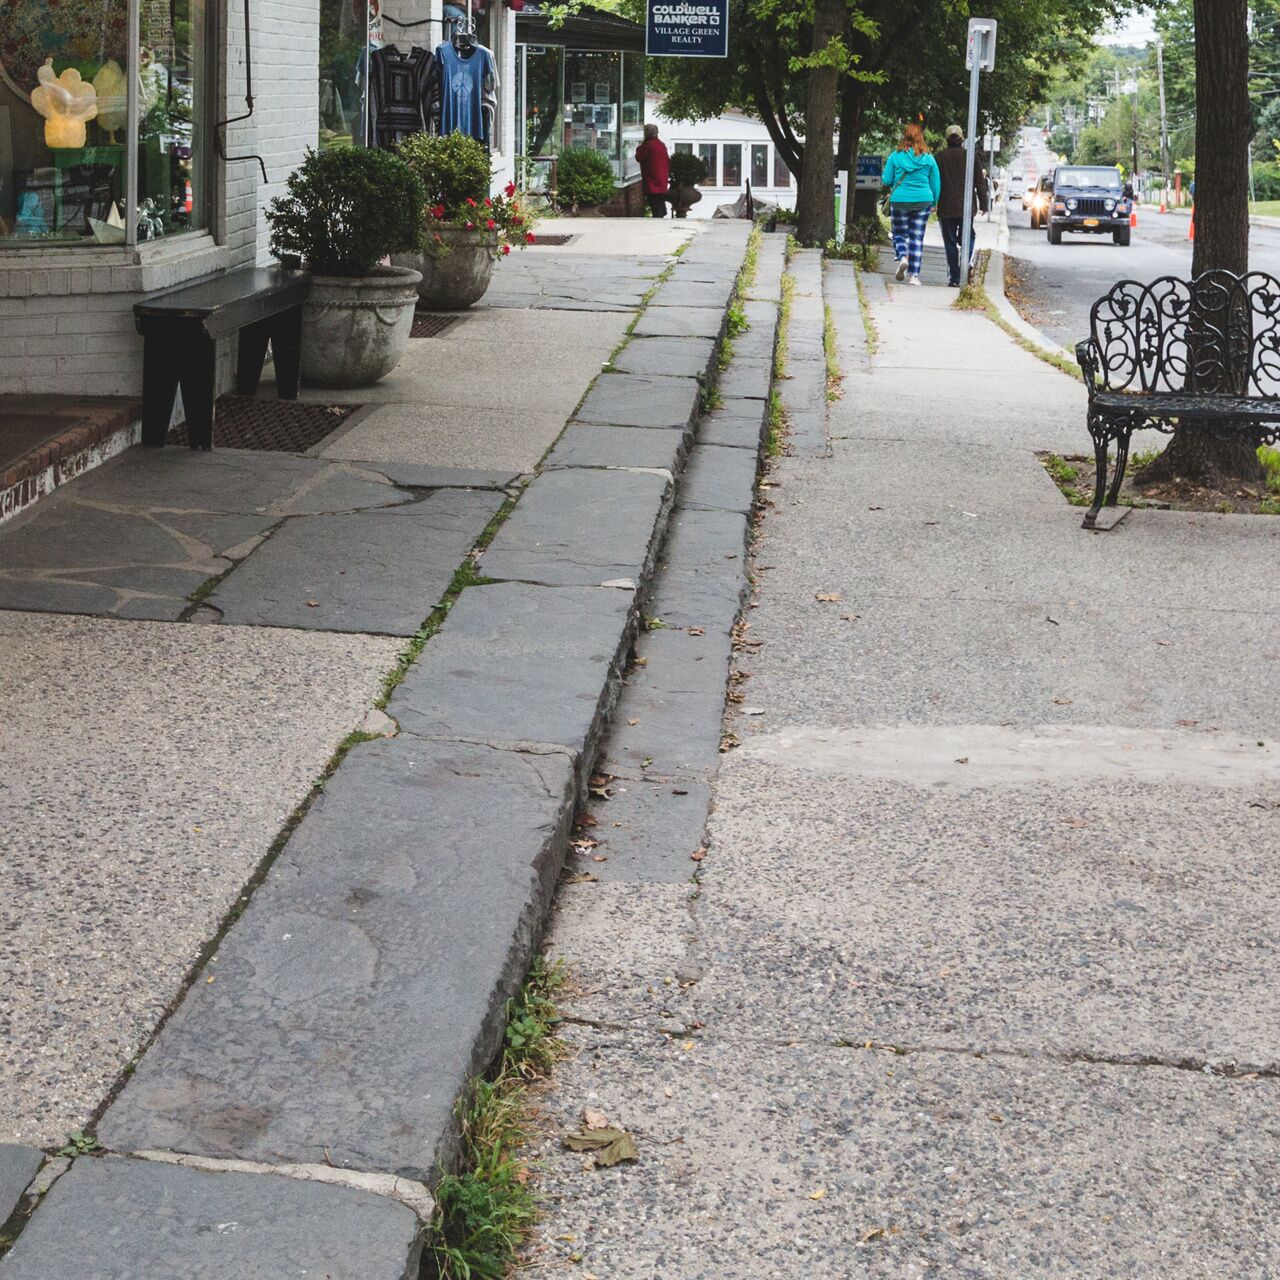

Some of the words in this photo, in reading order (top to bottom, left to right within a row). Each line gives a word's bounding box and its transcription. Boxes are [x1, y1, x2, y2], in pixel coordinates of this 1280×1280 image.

[652, 5, 720, 15] COLDWELL
[654, 14, 707, 25] BANKER
[655, 27, 690, 35] VILLAGE
